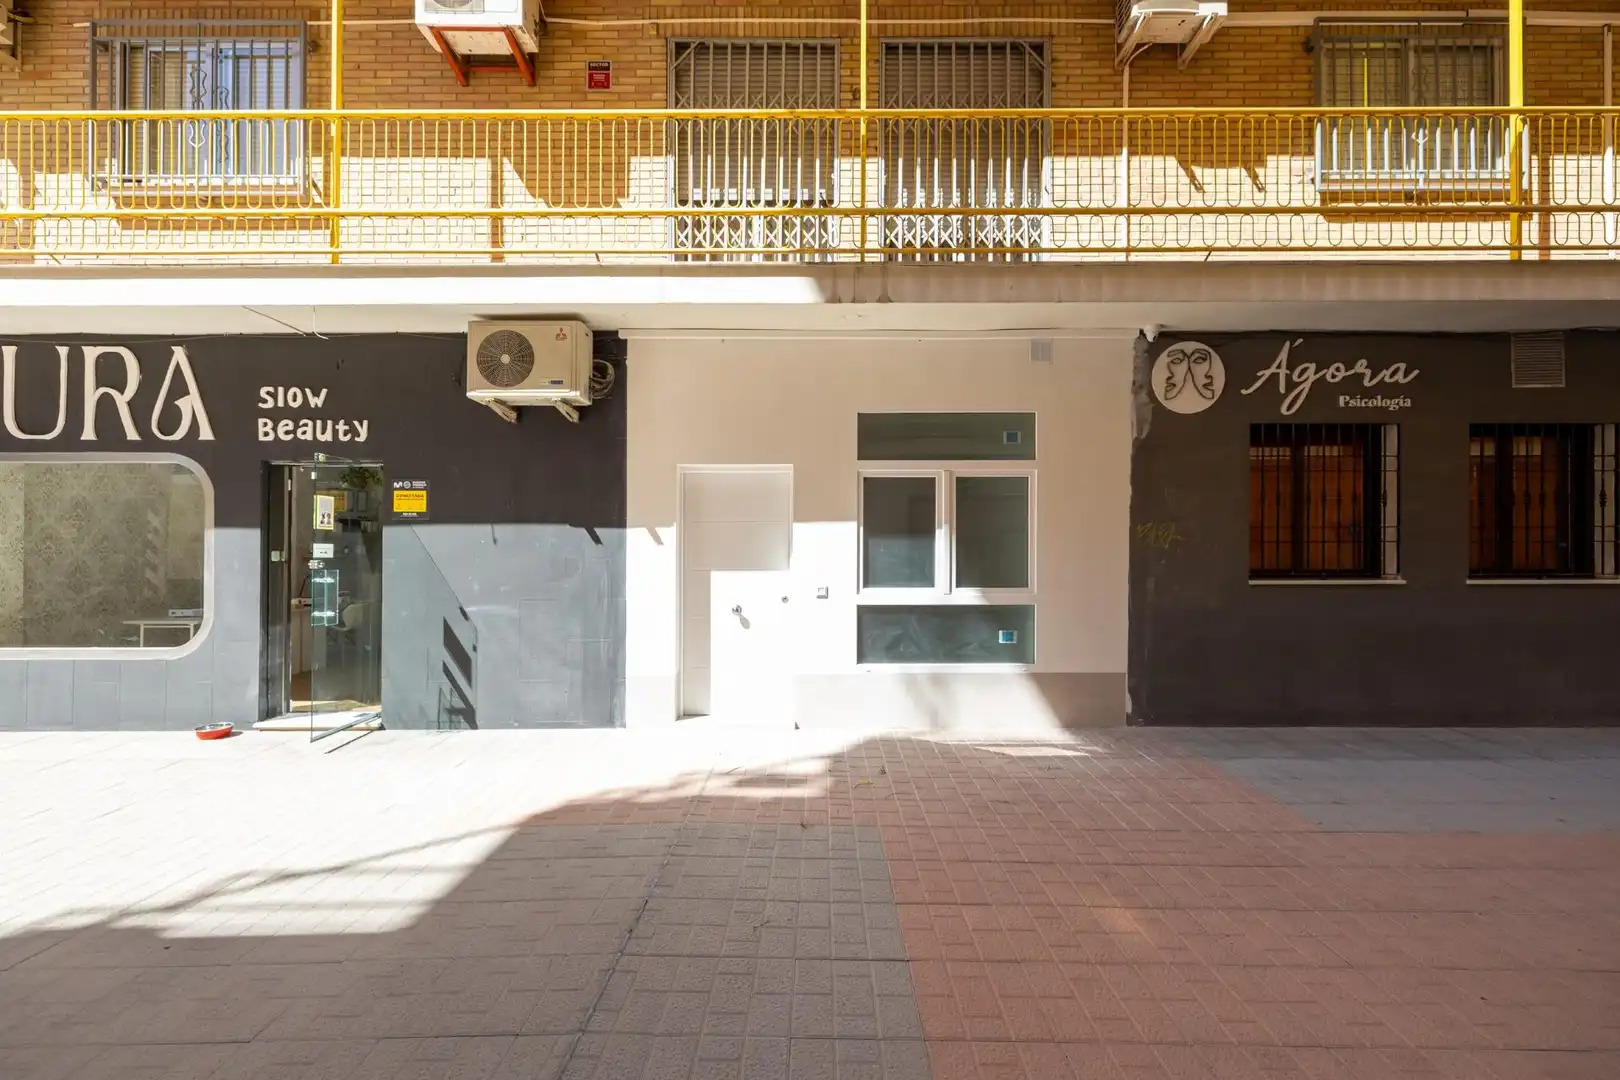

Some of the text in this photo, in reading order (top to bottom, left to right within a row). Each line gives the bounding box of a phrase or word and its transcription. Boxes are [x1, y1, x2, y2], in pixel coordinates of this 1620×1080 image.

[1, 345, 215, 441] URA
[1240, 338, 1420, 416] Ágora
[1338, 394, 1412, 411] Psicología
[257, 417, 369, 443] Beauty
